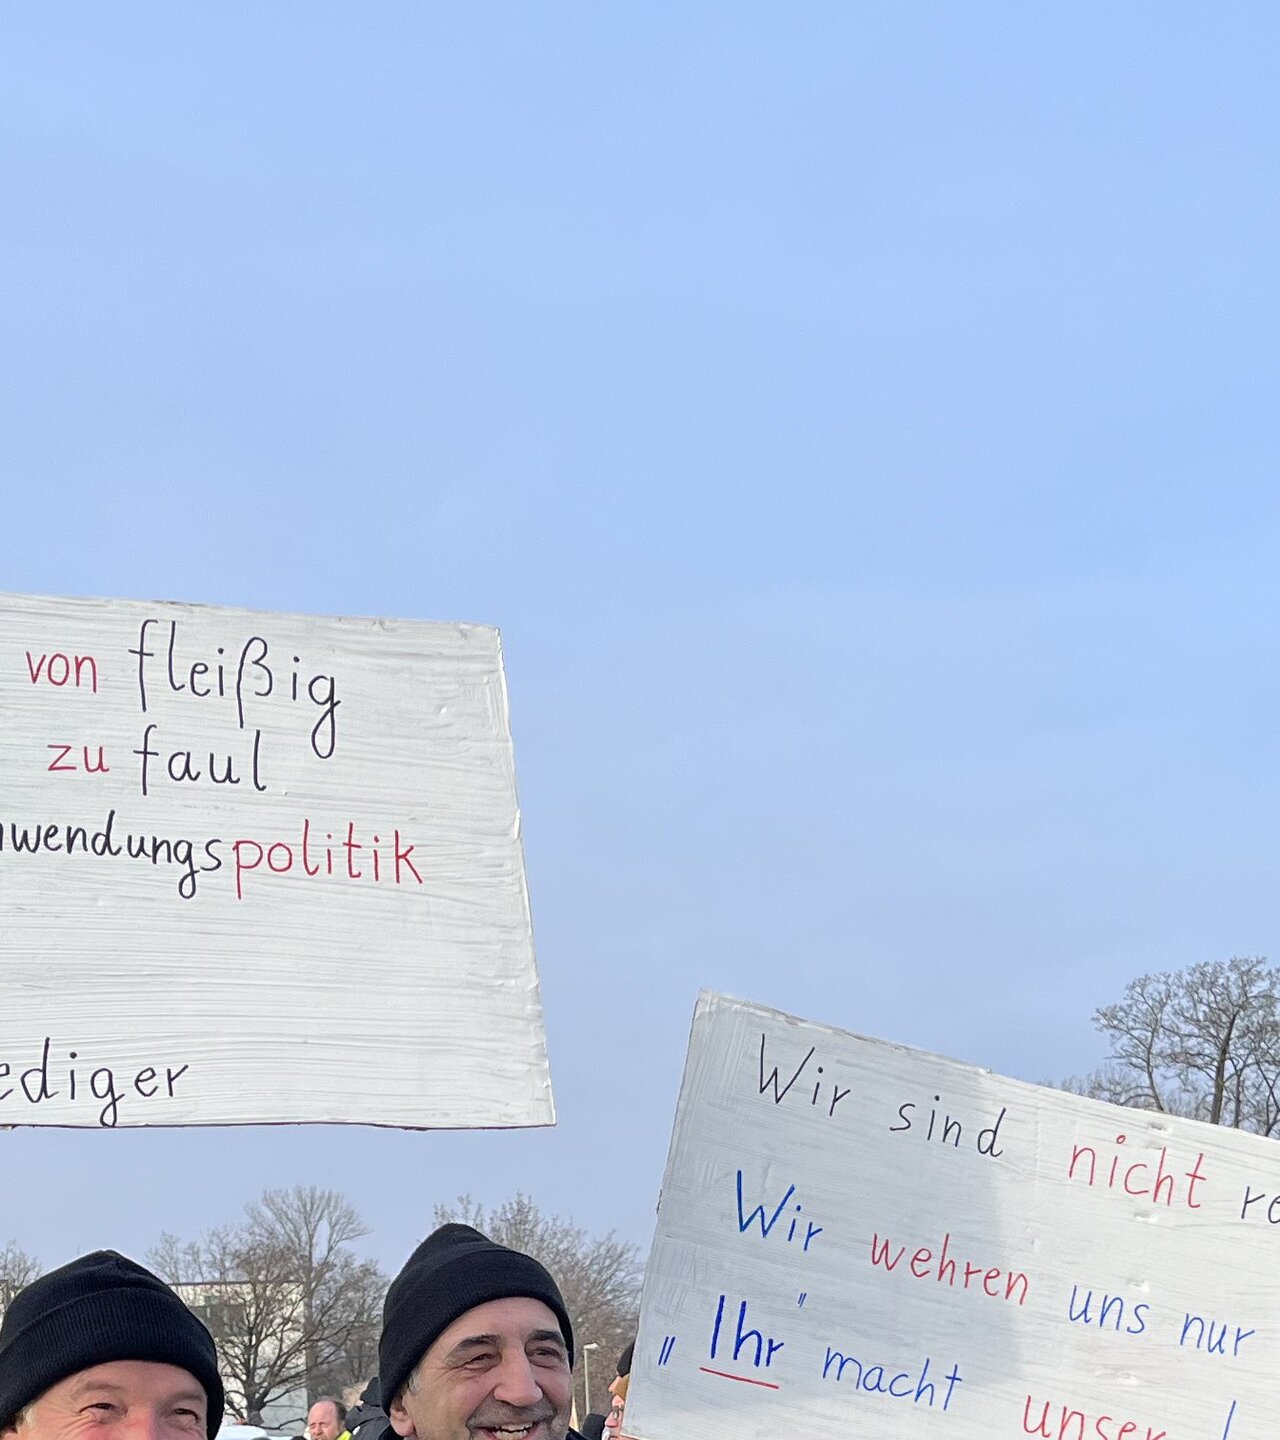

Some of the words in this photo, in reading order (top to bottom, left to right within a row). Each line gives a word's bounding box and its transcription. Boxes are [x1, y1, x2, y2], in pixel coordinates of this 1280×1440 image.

[26, 649, 98, 693] von
[128, 619, 342, 759] fleißig
[47, 742, 110, 774] zu
[133, 725, 268, 796] faul
[759, 1033, 851, 1116] Wir
[889, 1095, 1007, 1158] sind
[1069, 1135, 1207, 1209] nicht
[736, 1170, 823, 1251] Wir
[871, 1233, 1029, 1306] wehren
[1069, 1285, 1151, 1334] uns
[823, 1347, 963, 1411] macht
